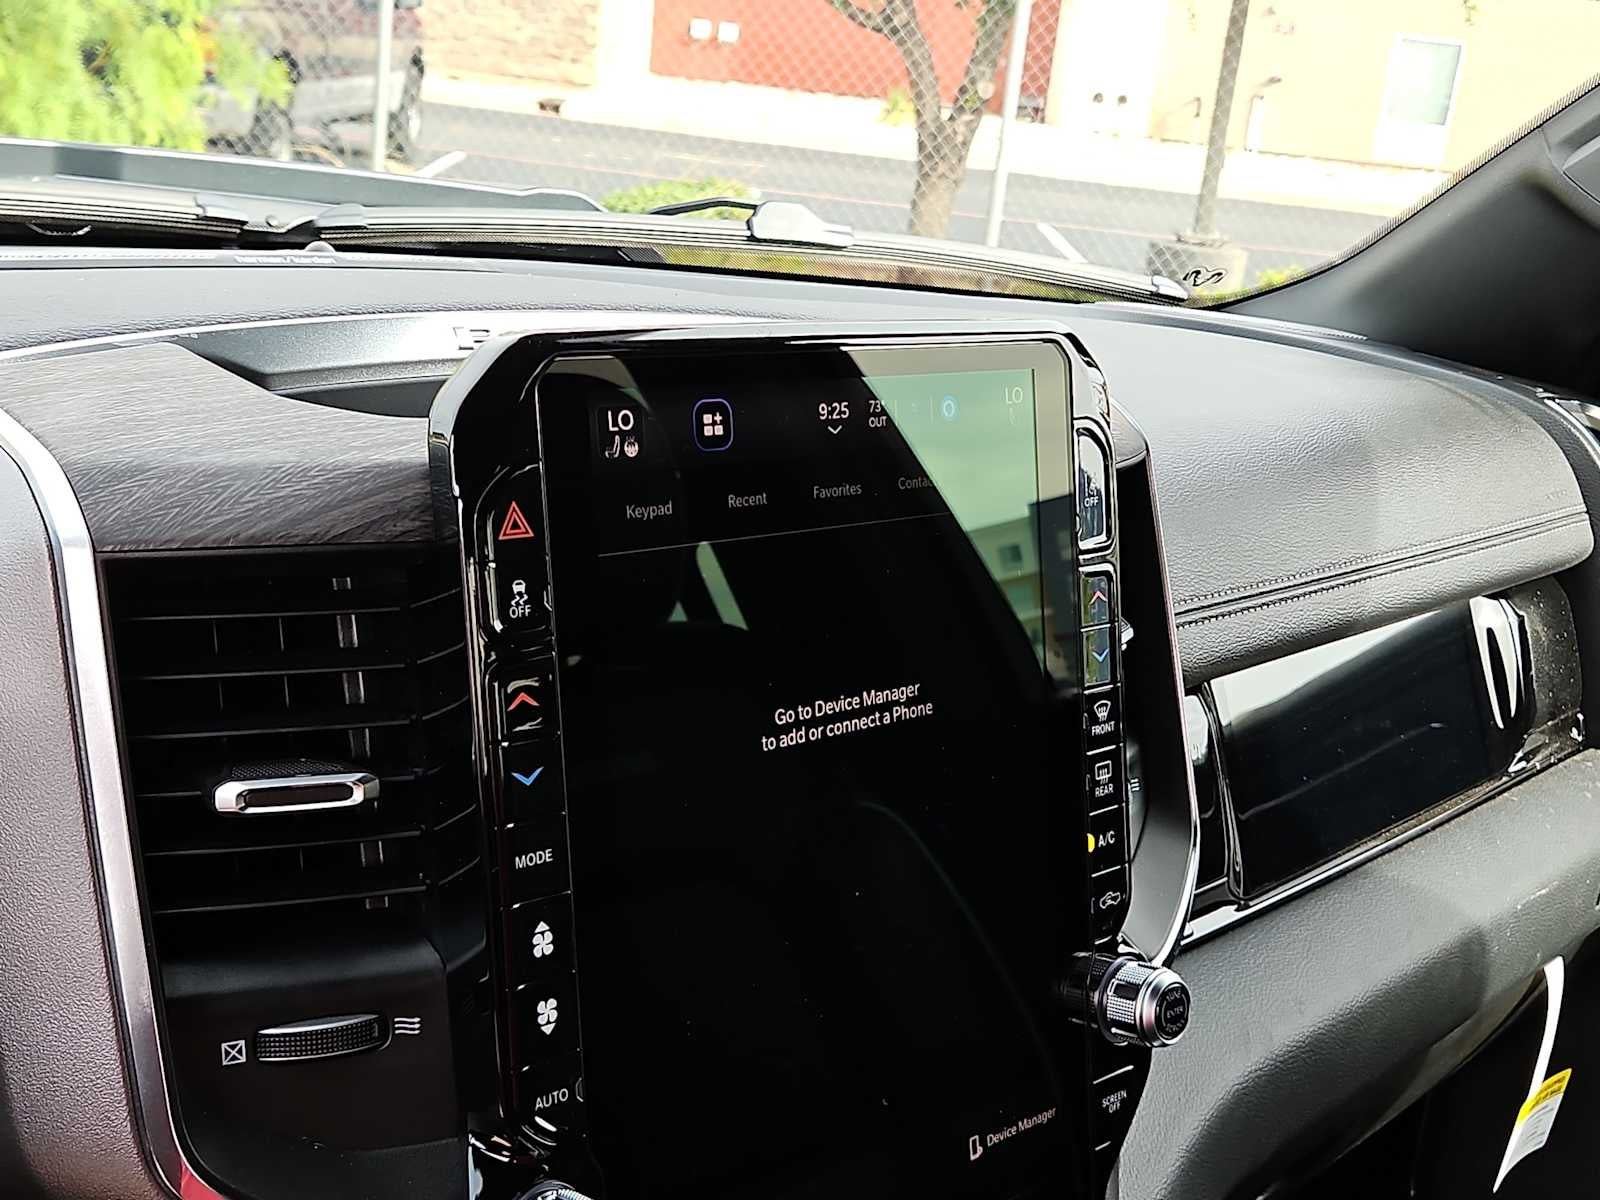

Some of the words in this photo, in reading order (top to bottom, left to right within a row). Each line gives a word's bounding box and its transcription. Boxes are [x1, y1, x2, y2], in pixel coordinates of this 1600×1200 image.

[1004, 386, 1024, 405] LO
[818, 402, 850, 420] 9:25
[607, 409, 635, 432] LO
[868, 416, 888, 428] OUT
[727, 492, 768, 508] Recent
[813, 483, 863, 500] Favorites
[625, 501, 673, 521] Keypad
[509, 604, 532, 619] OFF
[774, 708, 796, 725] Go
[798, 704, 813, 720] to
[815, 695, 861, 717] Device
[862, 683, 921, 707] Manager
[761, 735, 777, 752] to
[779, 726, 806, 748] add
[808, 725, 825, 741] or
[826, 711, 882, 737] connect
[882, 712, 892, 724] a
[892, 702, 934, 722] Phone
[1091, 721, 1116, 736] FRONT
[1095, 783, 1114, 798] REAR
[1098, 830, 1116, 848] A/C
[515, 848, 554, 870] MODE
[535, 1088, 569, 1112] AUTO
[1101, 1089, 1128, 1109] SCREEN
[1108, 1100, 1121, 1114] OFF
[986, 1127, 1018, 1148] Device
[1018, 1107, 1057, 1132] Manager
